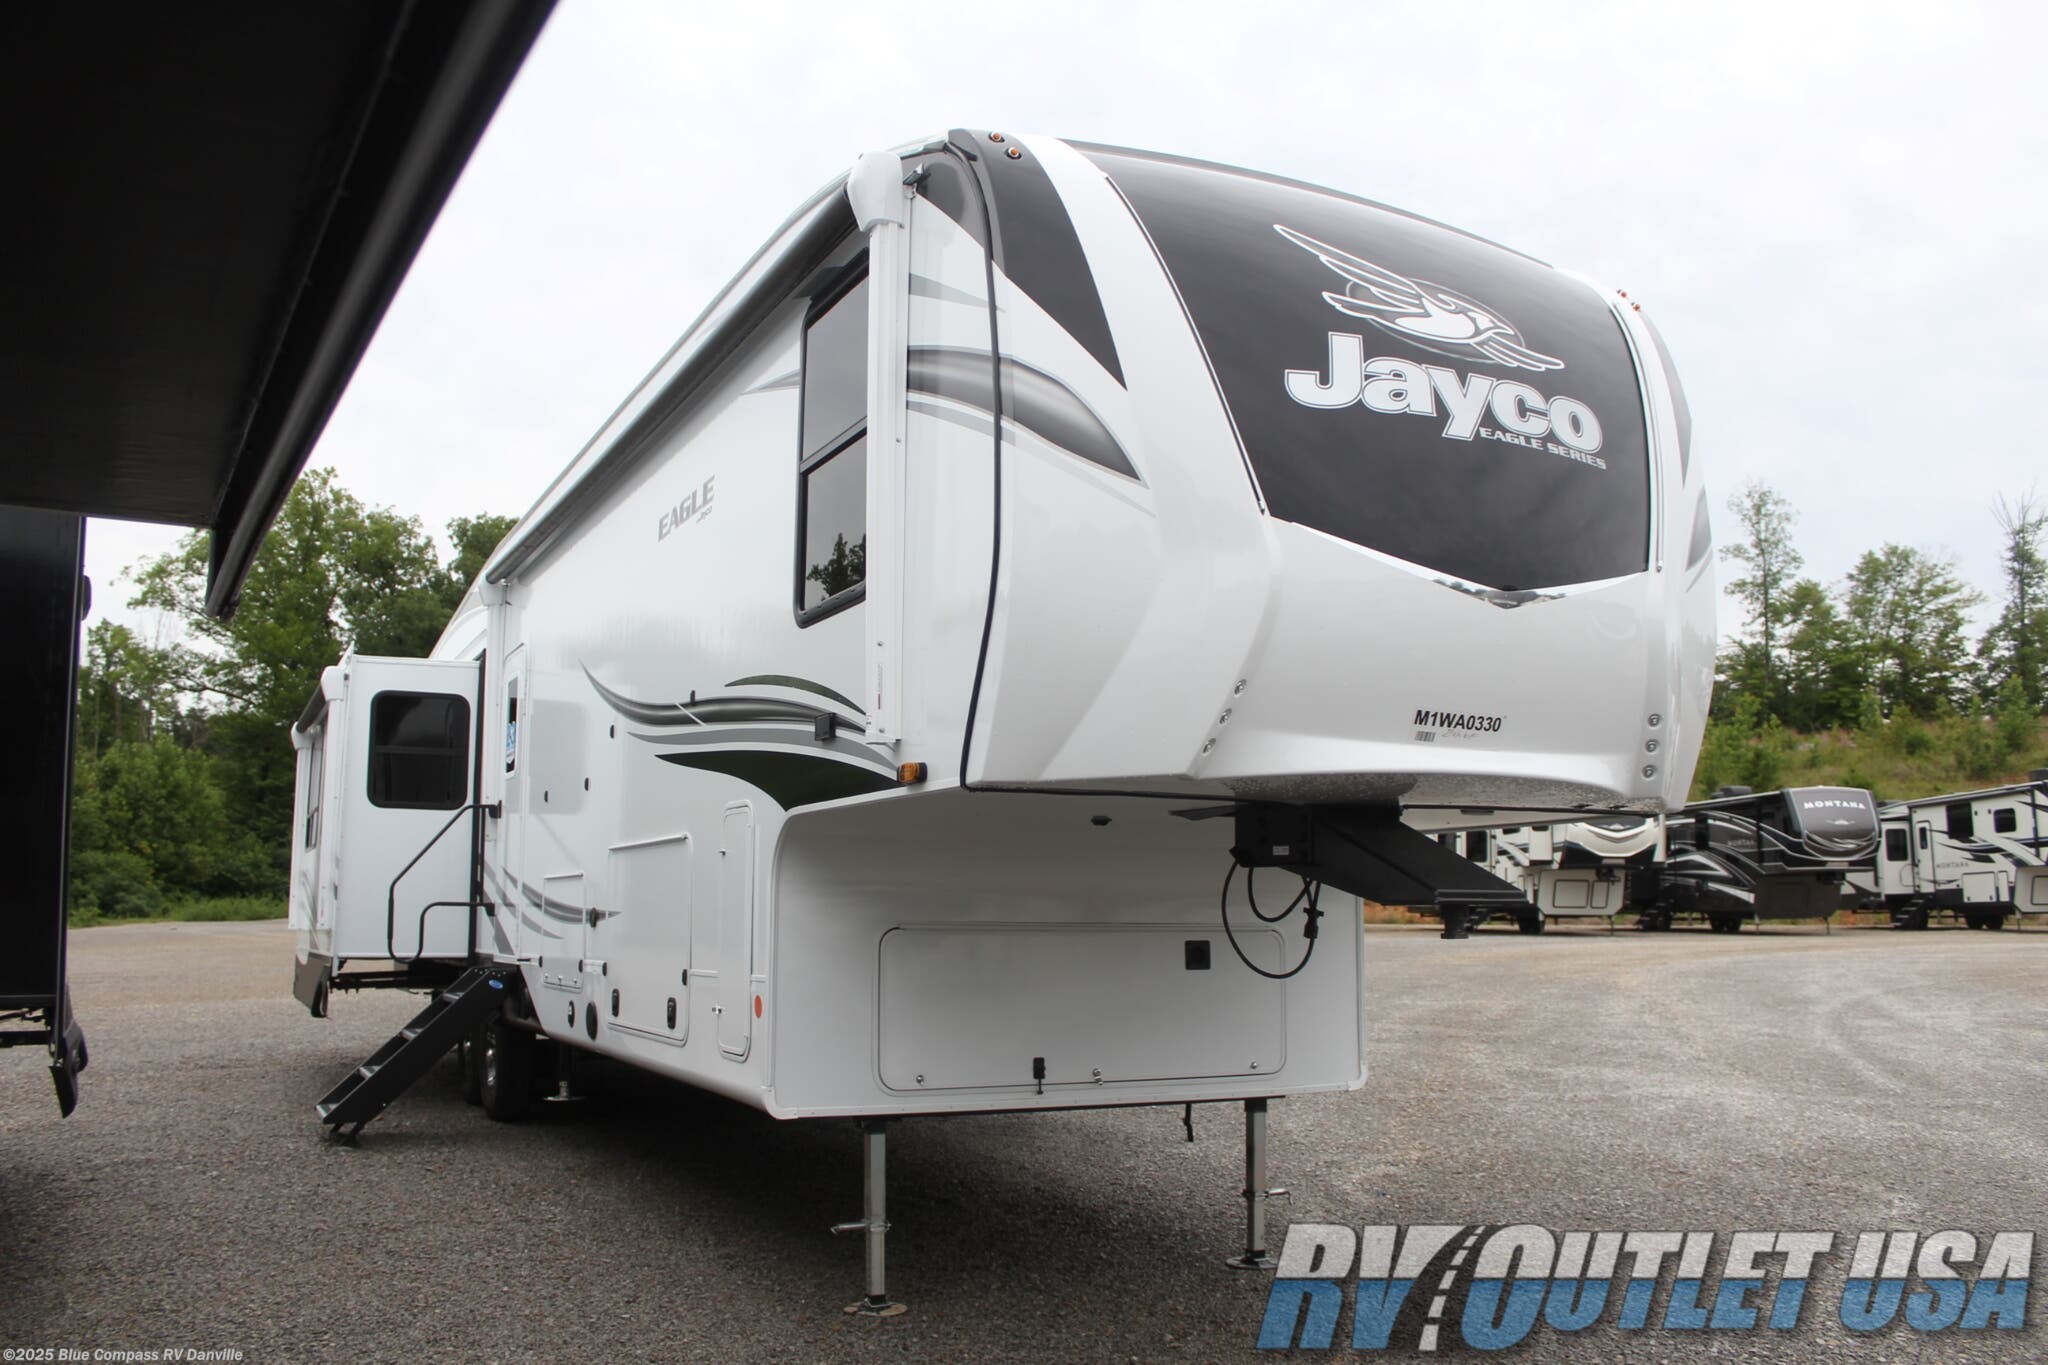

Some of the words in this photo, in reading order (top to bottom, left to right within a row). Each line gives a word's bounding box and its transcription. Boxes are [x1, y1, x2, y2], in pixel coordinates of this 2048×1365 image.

[1285, 332, 1603, 453] Jayco
[1479, 427, 1544, 450] EAGLE
[1547, 442, 1607, 470] SERIES
[658, 474, 715, 542] EAGLE
[1414, 709, 1502, 732] M1WA0330
[1803, 799, 1866, 809] MONTANA
